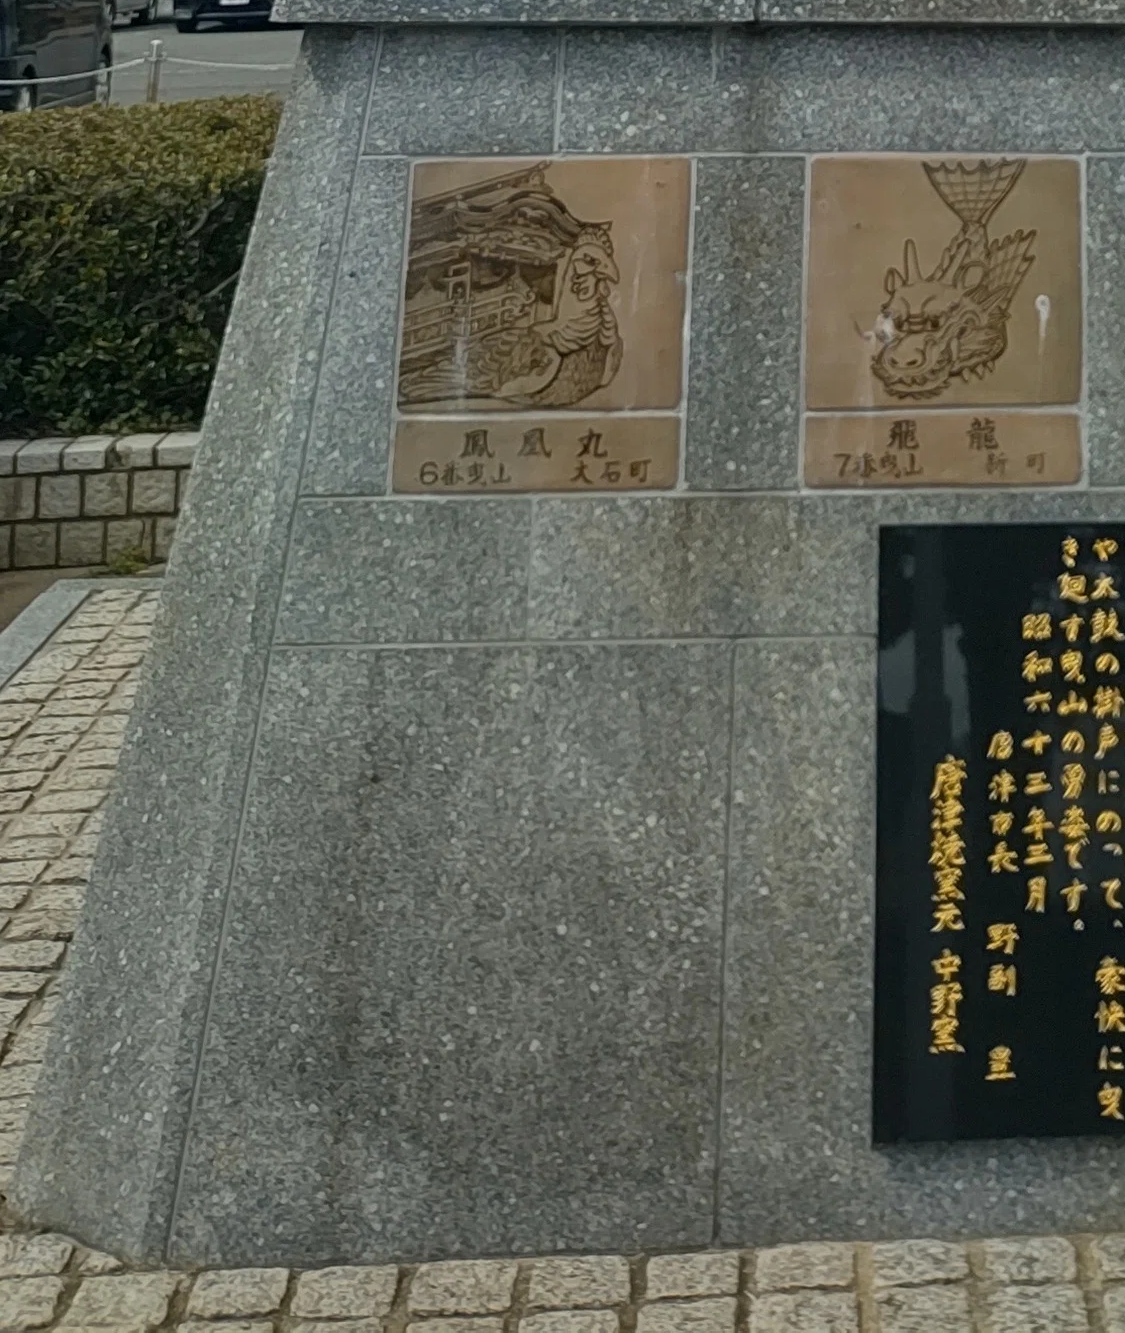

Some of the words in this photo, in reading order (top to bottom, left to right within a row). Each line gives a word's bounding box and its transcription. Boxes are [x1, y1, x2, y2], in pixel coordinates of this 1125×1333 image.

[459, 427, 608, 458] 鳳凰丸
[570, 459, 652, 484] 大石町
[886, 417, 999, 450] 飛龍
[986, 729, 1020, 874] 唐津市長
[1020, 612, 1054, 913] 昭和六十三年三月
[928, 752, 969, 933] 唐津焼窯元
[928, 947, 967, 1054] 中野窯
